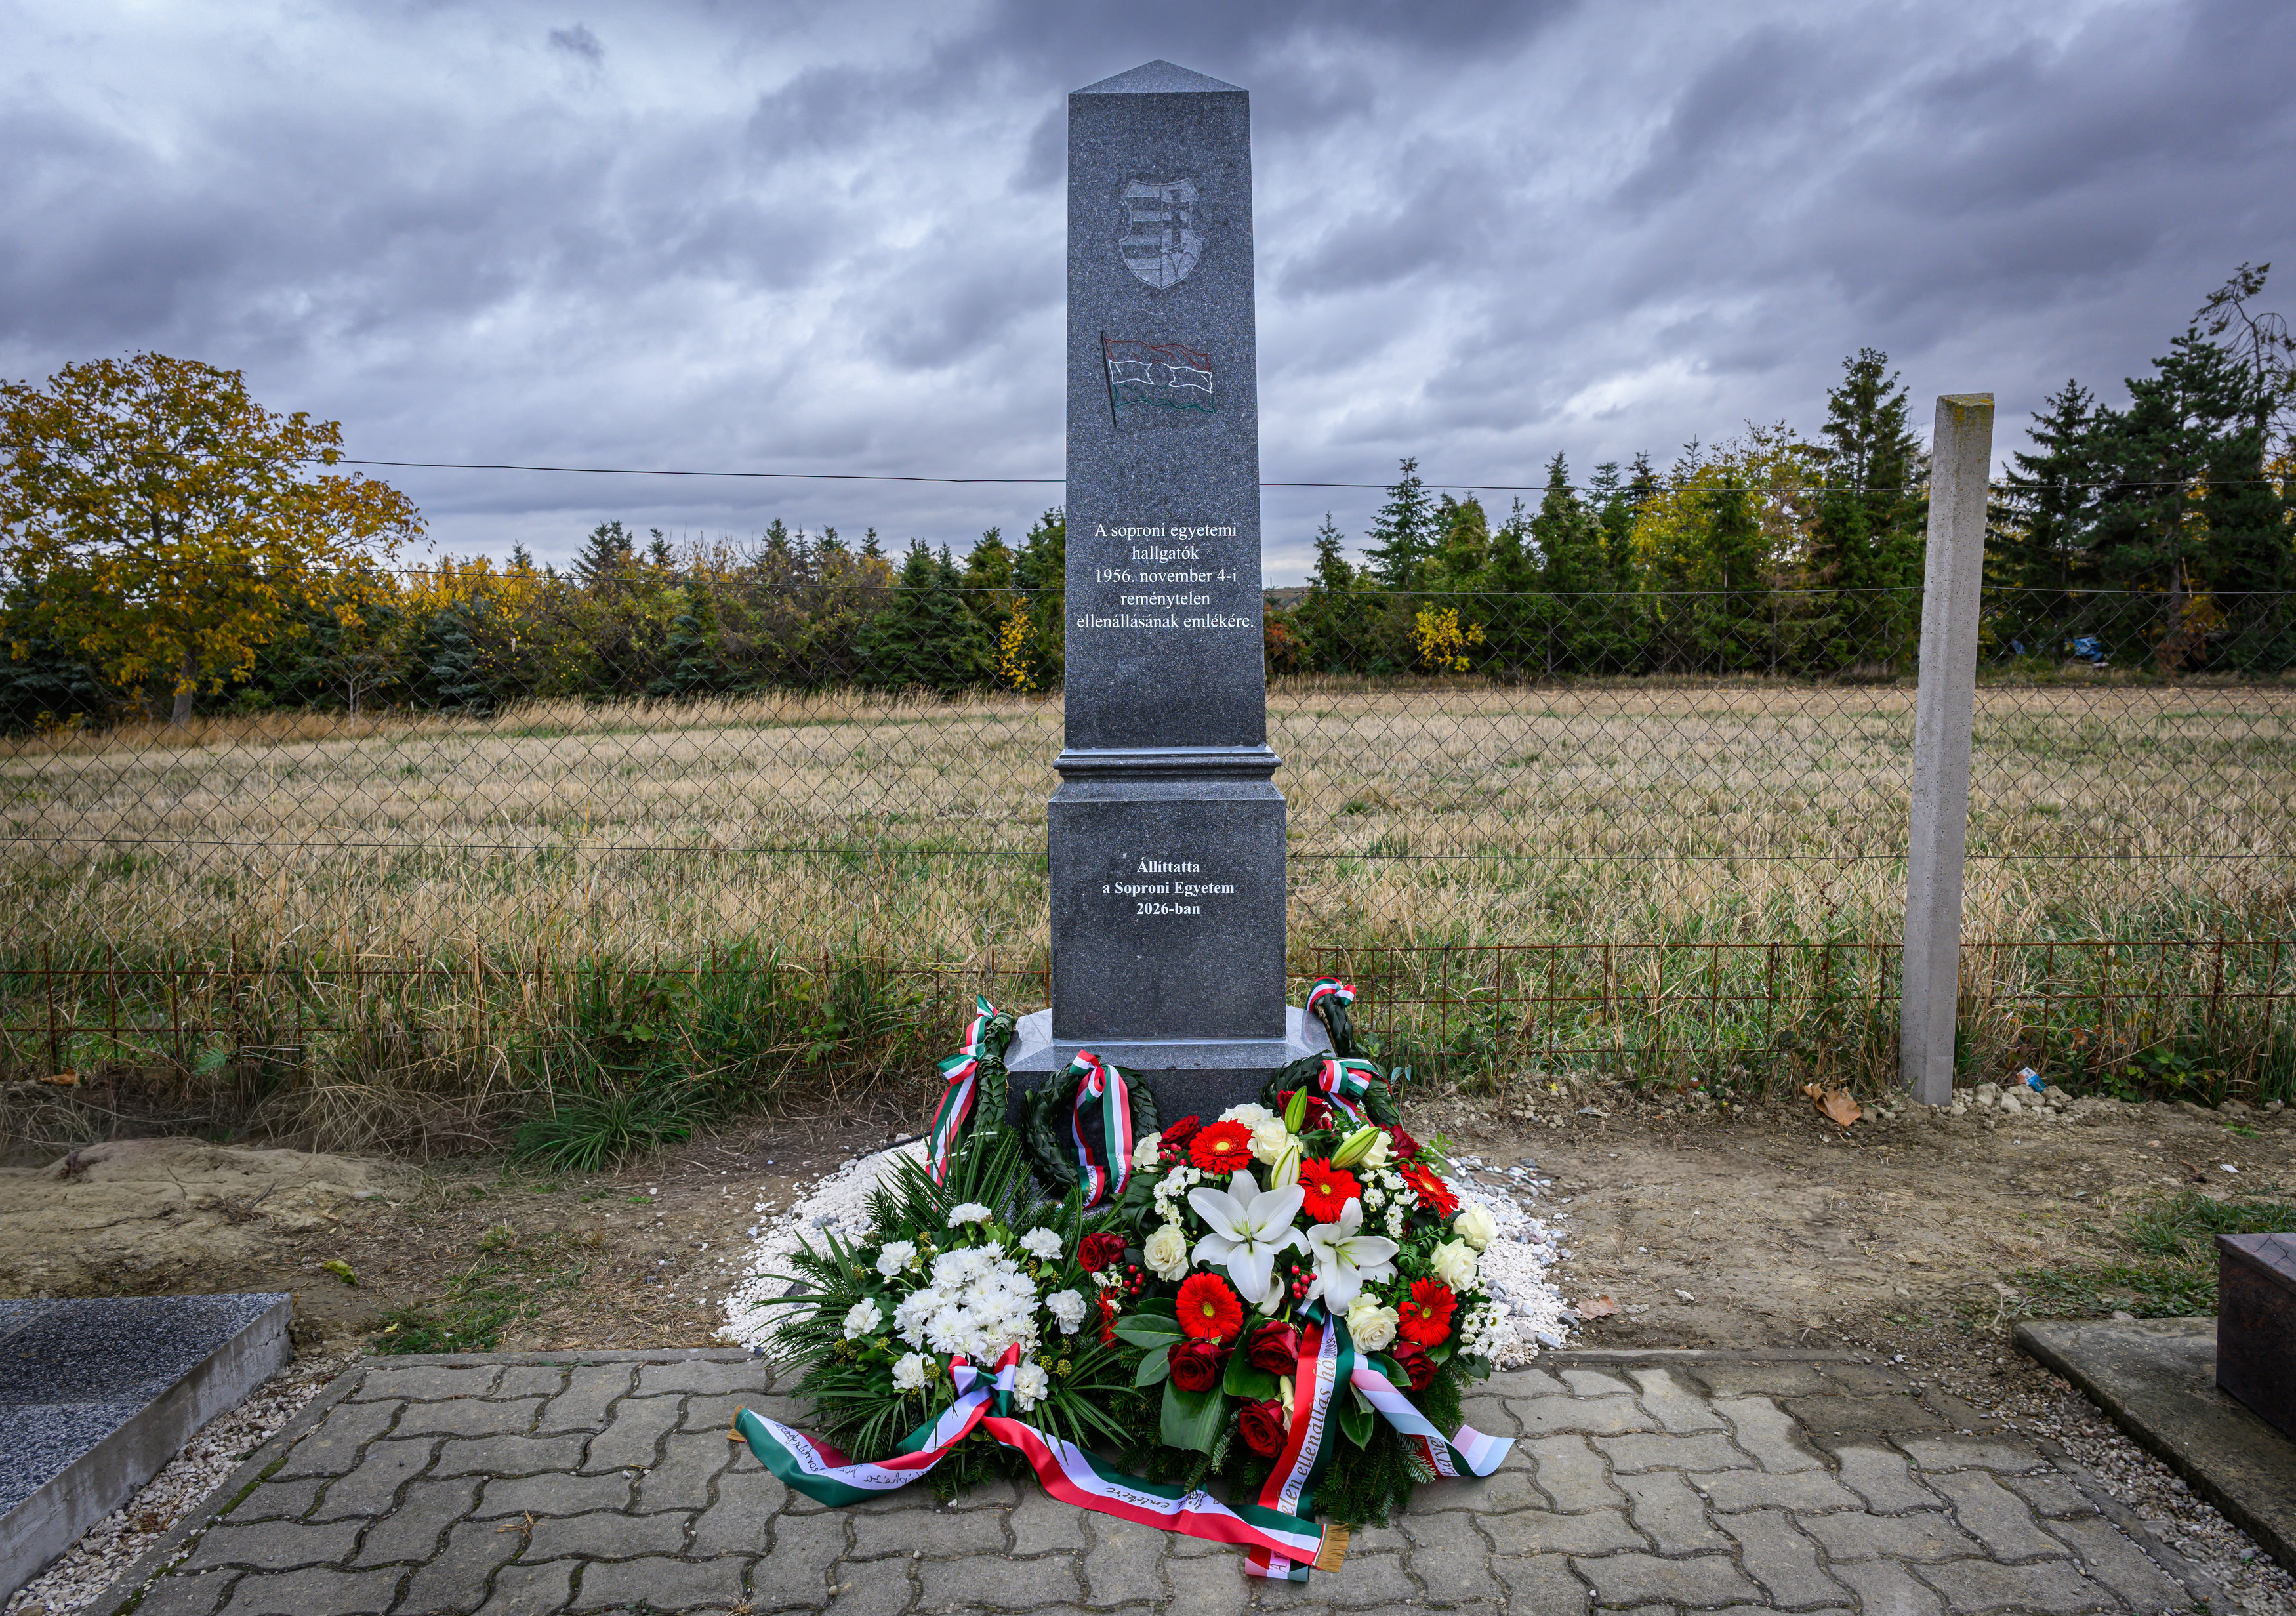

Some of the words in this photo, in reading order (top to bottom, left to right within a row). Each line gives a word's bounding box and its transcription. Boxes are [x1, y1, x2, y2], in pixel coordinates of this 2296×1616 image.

[1094, 523, 1107, 537] A
[1111, 523, 1165, 541] soproni
[1170, 522, 1237, 541] egyetemi
[1132, 545, 1199, 564] hallgatók
[1096, 568, 1134, 583] 1956.
[1139, 567, 1213, 583] november
[1216, 568, 1237, 582] 4-i
[1120, 590, 1210, 609] reménytelen
[1076, 613, 1179, 628] ellenállásának
[1183, 613, 1254, 628] emlékére.
[1137, 856, 1200, 873] Állíttatta
[1103, 884, 1110, 894] a
[1115, 881, 1170, 897] Soproni
[1174, 881, 1234, 897] Egyetem
[1137, 902, 1200, 915] 2026-ban
[1294, 1388, 1331, 1480] ellenállás
